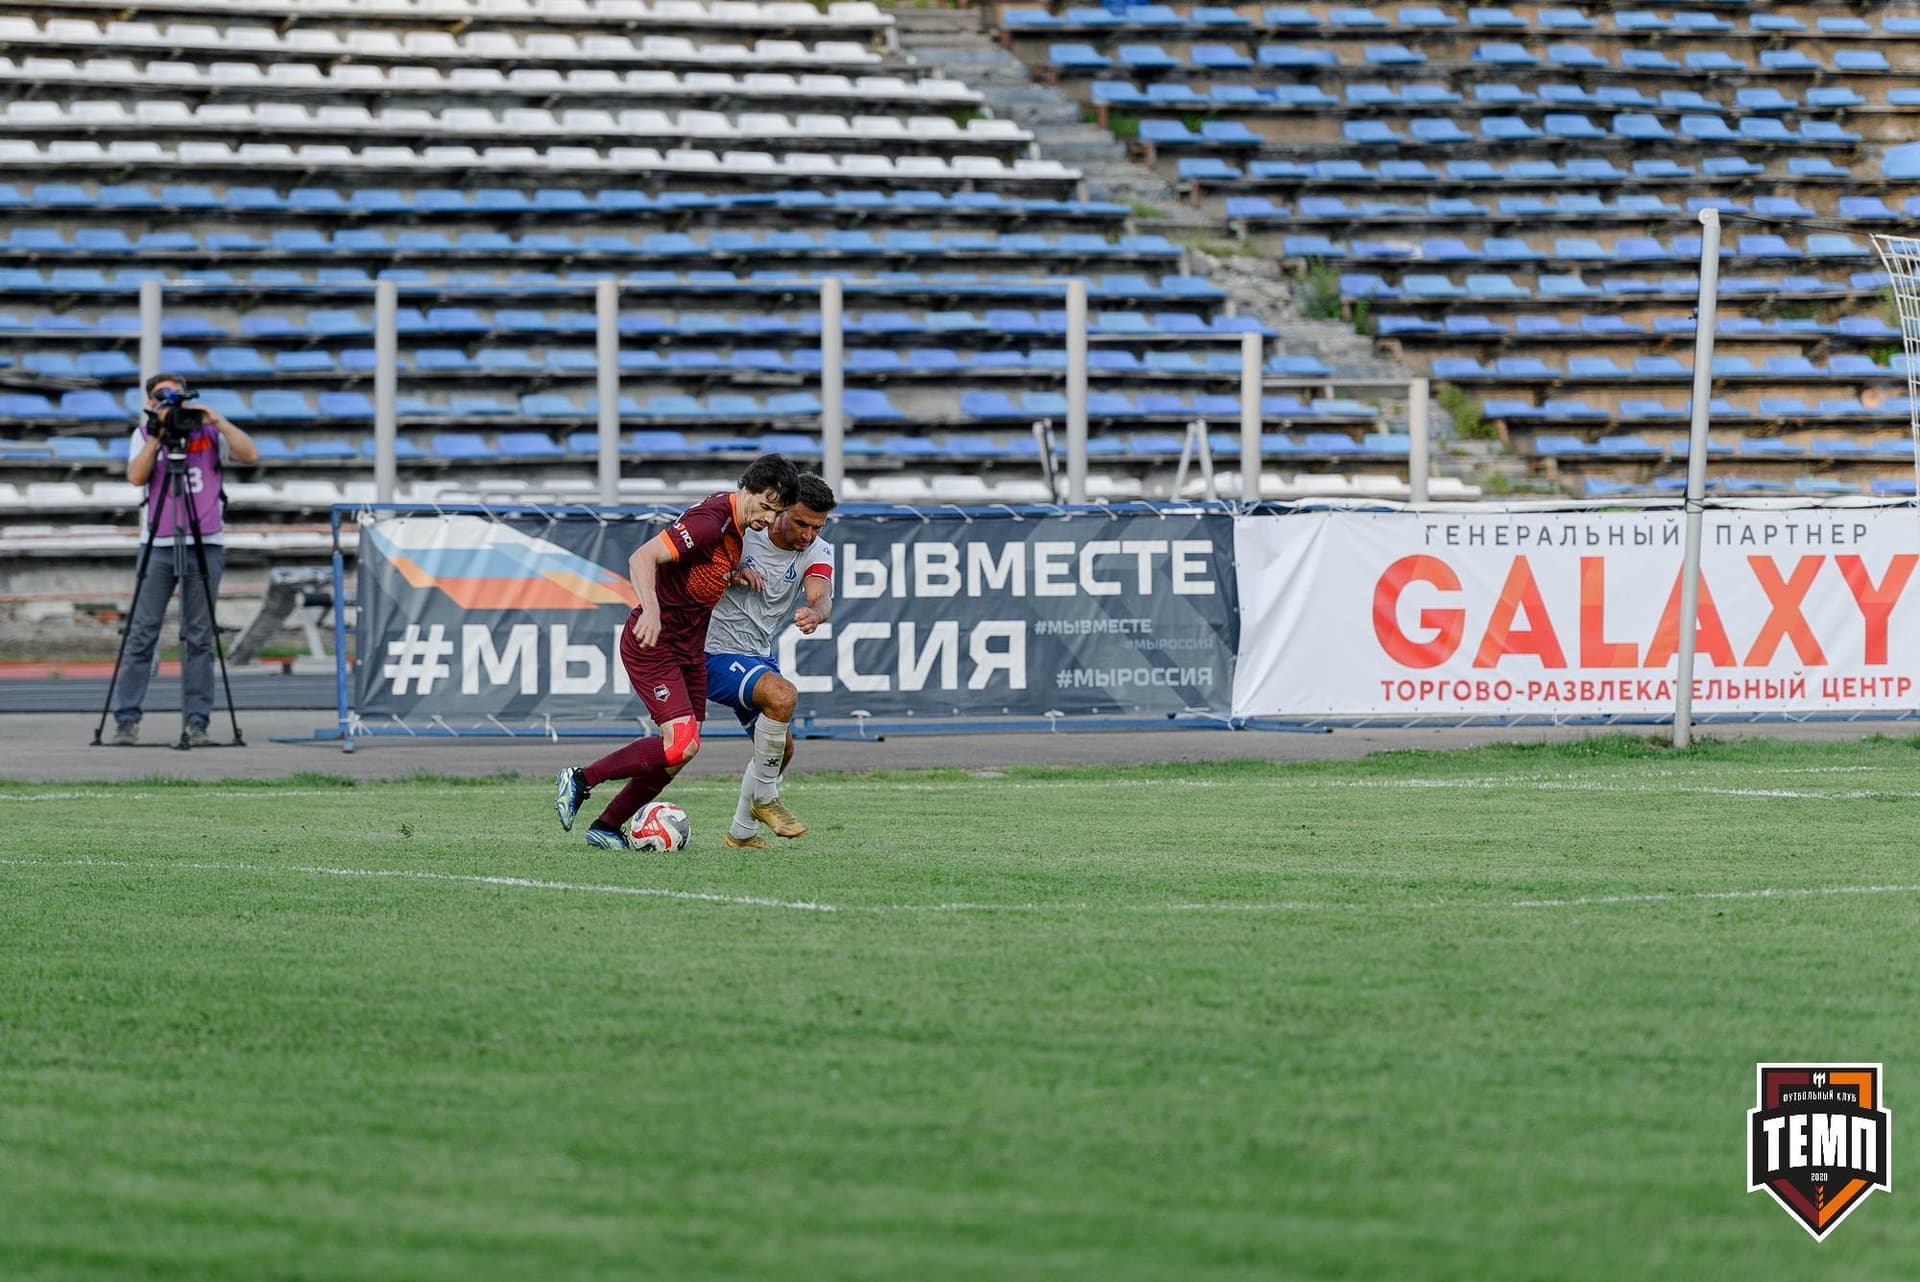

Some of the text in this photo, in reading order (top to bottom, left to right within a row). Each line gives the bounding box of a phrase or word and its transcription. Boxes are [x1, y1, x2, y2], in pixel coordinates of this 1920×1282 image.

[1425, 518, 1868, 546] ГЕНЕРАЛЬНЫЙ ПАРТНЕР
[829, 540, 1216, 600] ЫВМЕСТЕ
[1372, 553, 1920, 670] GALAXY
[1034, 618, 1153, 635] #МЫВМЕСТЕ
[384, 620, 1027, 696] #МЫССИЯ
[729, 661, 746, 674] 7
[1057, 667, 1213, 688] #МЫРОССИЯ
[1381, 673, 1912, 702] ТОРГОВО-РАЗВЛЕКАЕЛЬНЫЙ ЦЕНТР
